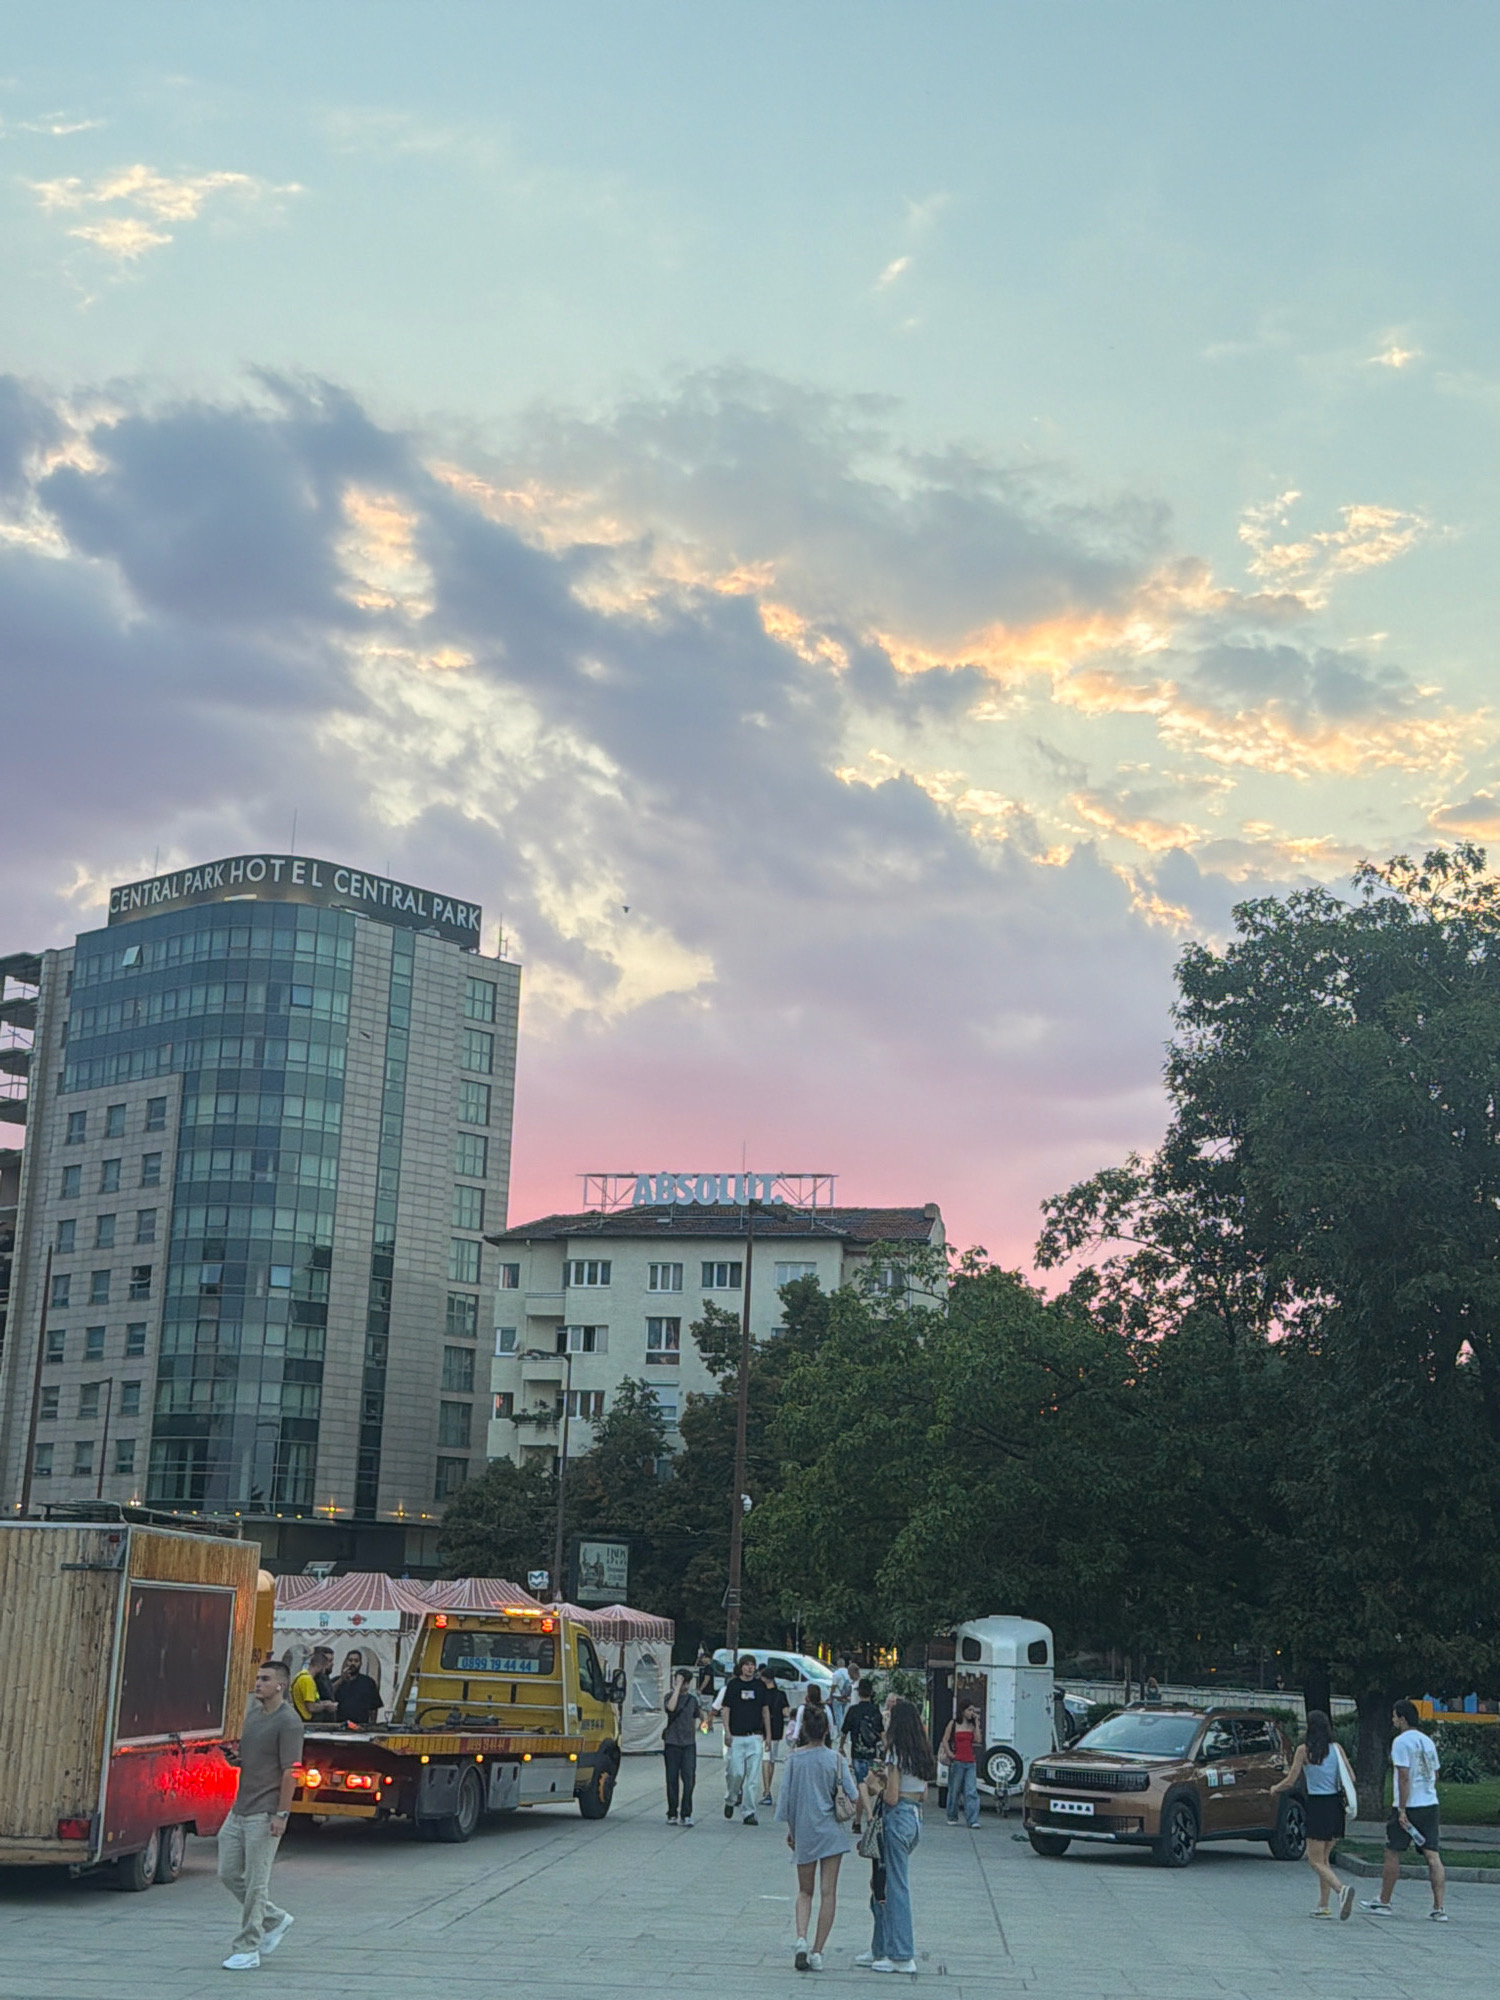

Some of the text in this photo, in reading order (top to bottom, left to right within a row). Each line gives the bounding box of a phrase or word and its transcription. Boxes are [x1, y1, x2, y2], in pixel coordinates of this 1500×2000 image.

[110, 858, 480, 931] CENTRAL PARK HOTEL CENTRAL PARK
[504, 1659, 516, 1671] 44
[519, 1660, 532, 1672] 44
